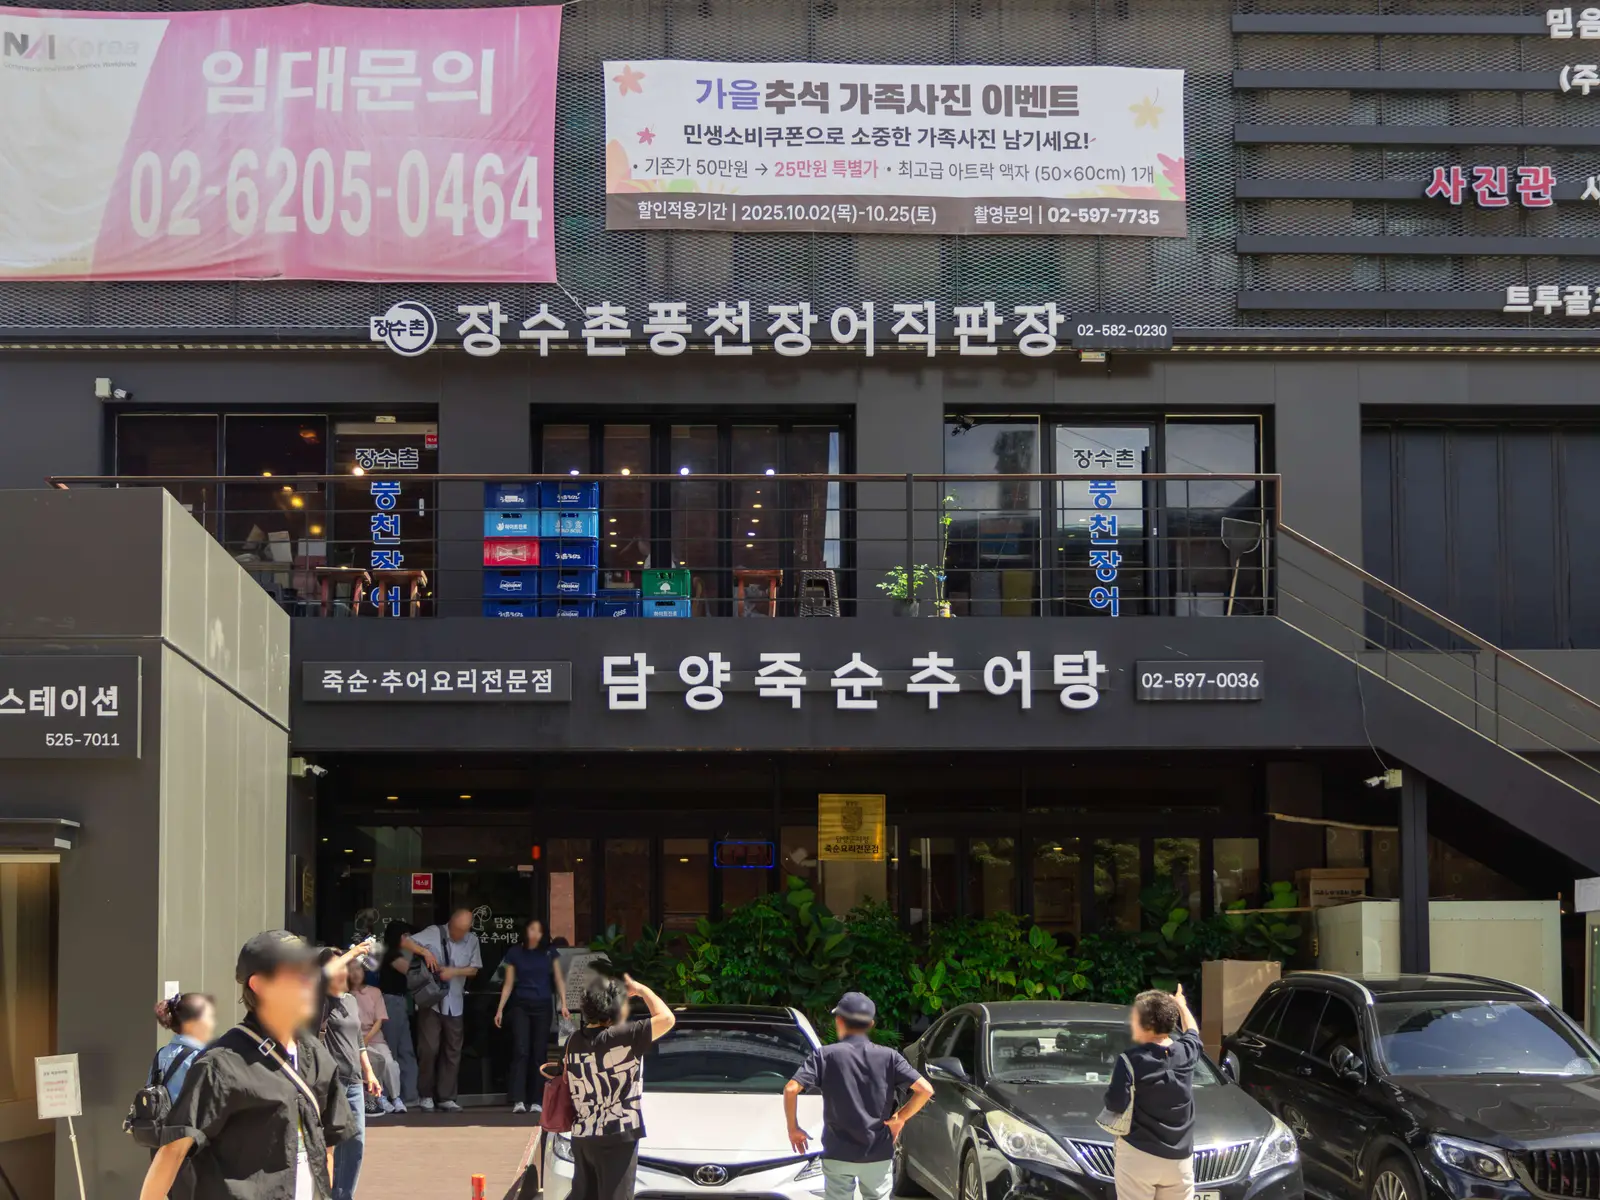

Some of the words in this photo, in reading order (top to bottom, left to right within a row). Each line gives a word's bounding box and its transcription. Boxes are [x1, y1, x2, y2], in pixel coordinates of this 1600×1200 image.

[3, 31, 56, 60] NAI
[202, 46, 496, 116] 임대문의
[840, 82, 972, 116] 가족사진
[982, 84, 1079, 118] 이벤트
[683, 123, 846, 148] 민생소비쿠폰으로
[850, 125, 912, 148] 소중한
[917, 127, 996, 150] 가족사진
[1002, 129, 1089, 152] 남기세요!
[645, 157, 691, 177] 기존가
[696, 159, 748, 178] 50만원
[774, 160, 827, 179] 25만원
[832, 160, 879, 179] 특별가
[898, 161, 944, 180] 최고급
[948, 163, 995, 181] 아트락
[999, 163, 1030, 182] 액자
[1131, 165, 1155, 184] 1개
[129, 147, 543, 239] 02-6205-0464
[1425, 166, 1557, 207] 사진관
[637, 200, 727, 221] 할인적용기간
[741, 204, 937, 226] 2025.10.02(목)-10.25(토)
[974, 206, 1033, 225] 촬영문의
[1047, 207, 1160, 226] 02-597-7735
[1503, 285, 1600, 316] 트루골
[373, 318, 426, 338] 장수촌
[456, 301, 1065, 358] 장수촌풍천장어직판장
[1077, 324, 1168, 337] 02-582-0230
[355, 447, 419, 470] 장수촌
[1072, 448, 1135, 470] 장수촌
[1088, 479, 1122, 617] 풍천장어
[321, 668, 553, 694] 죽순·추어요리전문점
[603, 650, 1106, 710] 담양죽순추어탕
[1141, 672, 1260, 688] 02-597-0036
[0, 686, 119, 717] 스테이션
[45, 732, 120, 747] 525-7011
[493, 917, 514, 929] 담양
